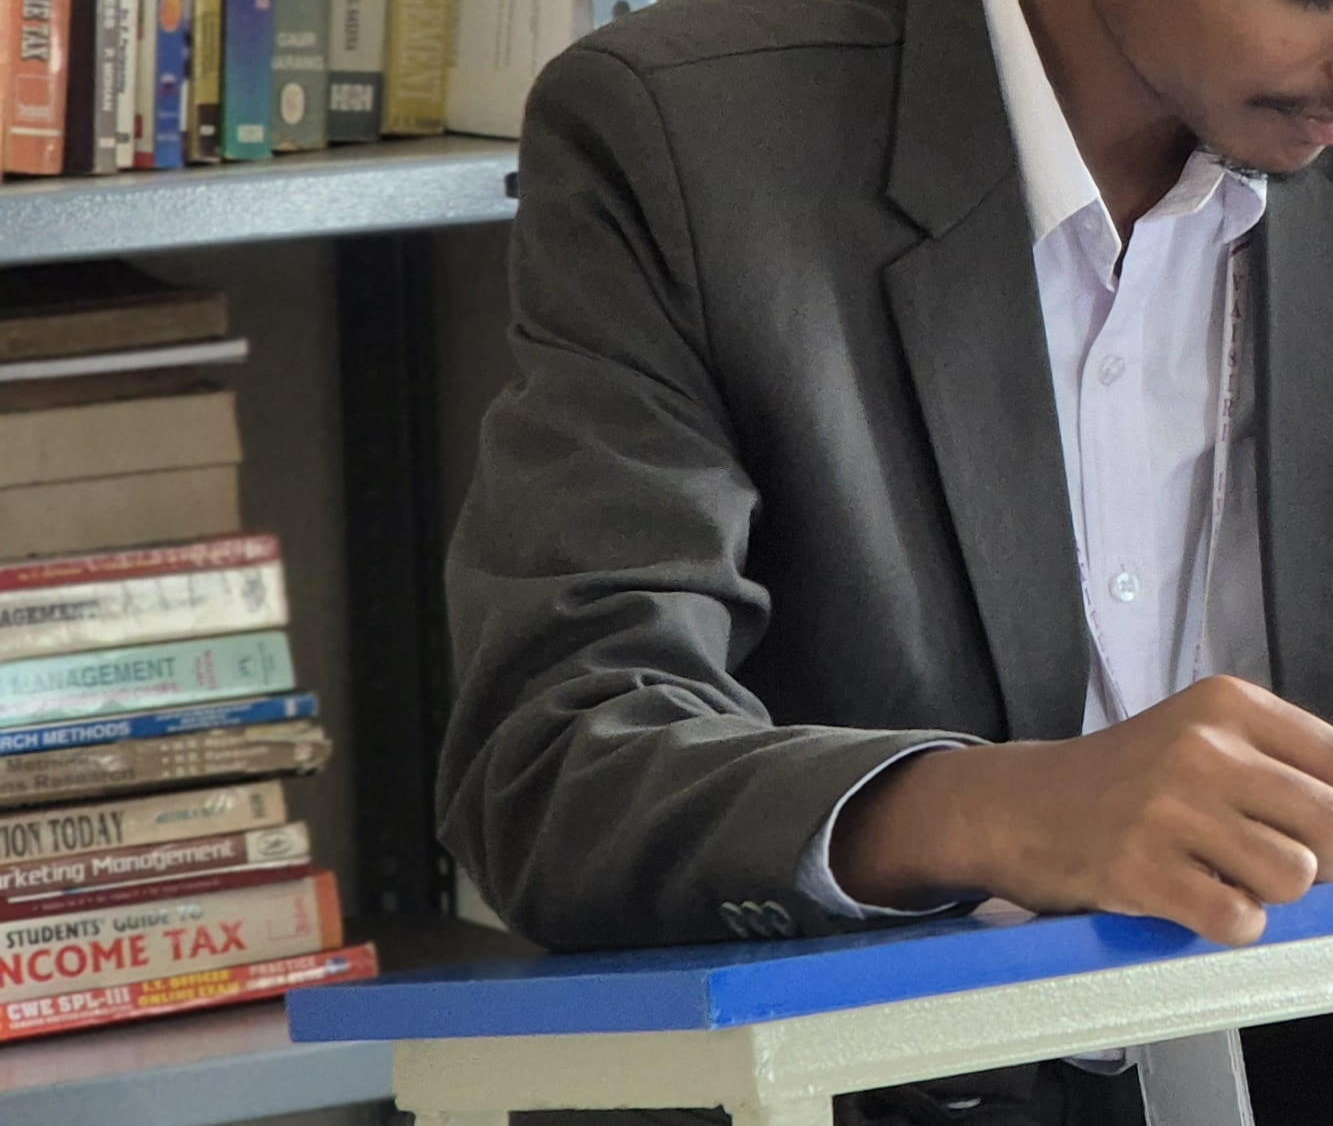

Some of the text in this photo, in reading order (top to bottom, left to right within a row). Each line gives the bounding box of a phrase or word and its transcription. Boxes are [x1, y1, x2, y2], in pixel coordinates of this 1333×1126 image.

[20, 24, 52, 62] TAX
[43, 721, 132, 745] METHODS
[49, 810, 125, 853] TODAY
[92, 838, 236, 876] Management
[113, 907, 170, 932] GUIDE
[175, 902, 204, 923] TO
[163, 919, 248, 963] TAX
[7, 985, 131, 1021] CWE SPL-III
[139, 980, 241, 1007] ONLINE EXAM
